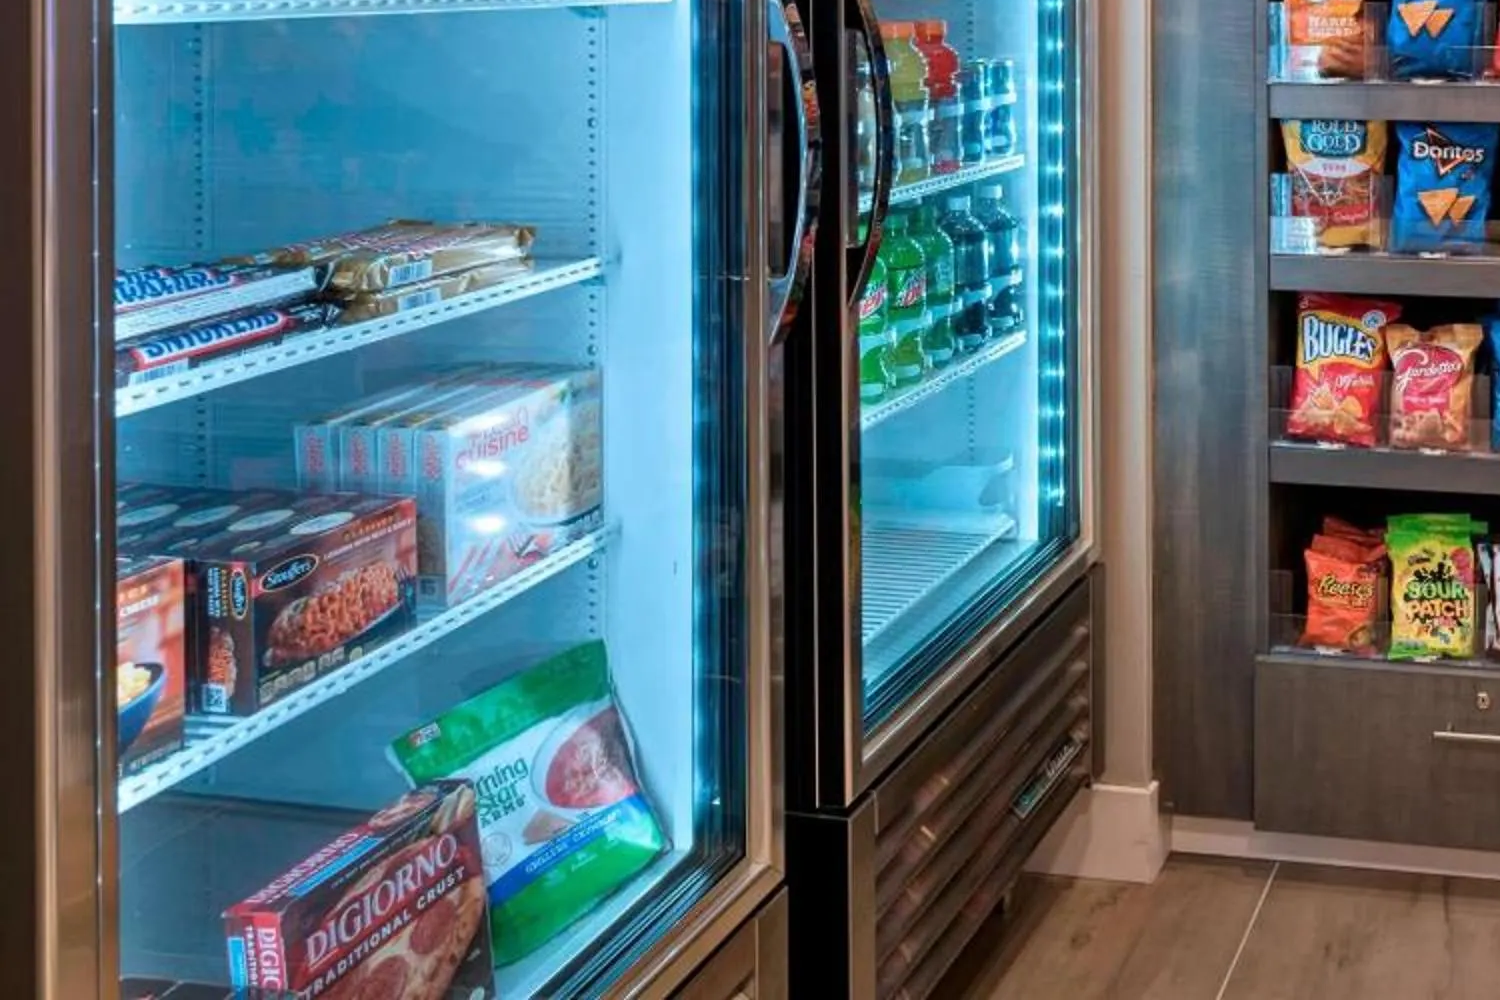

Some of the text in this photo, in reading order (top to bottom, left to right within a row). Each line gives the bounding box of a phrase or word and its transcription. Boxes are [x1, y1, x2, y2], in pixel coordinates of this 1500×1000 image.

[1307, 133, 1361, 151] GOLD
[1413, 140, 1485, 163] Doritos
[1303, 315, 1376, 362] BUGLES
[1407, 580, 1465, 599] SOUR
[1409, 600, 1467, 618] PATCH
[475, 757, 530, 796] rning
[480, 799, 526, 829] ARMS
[305, 833, 458, 967] DIGIORNO
[303, 864, 465, 1000] TRADITIONAL CRUST
